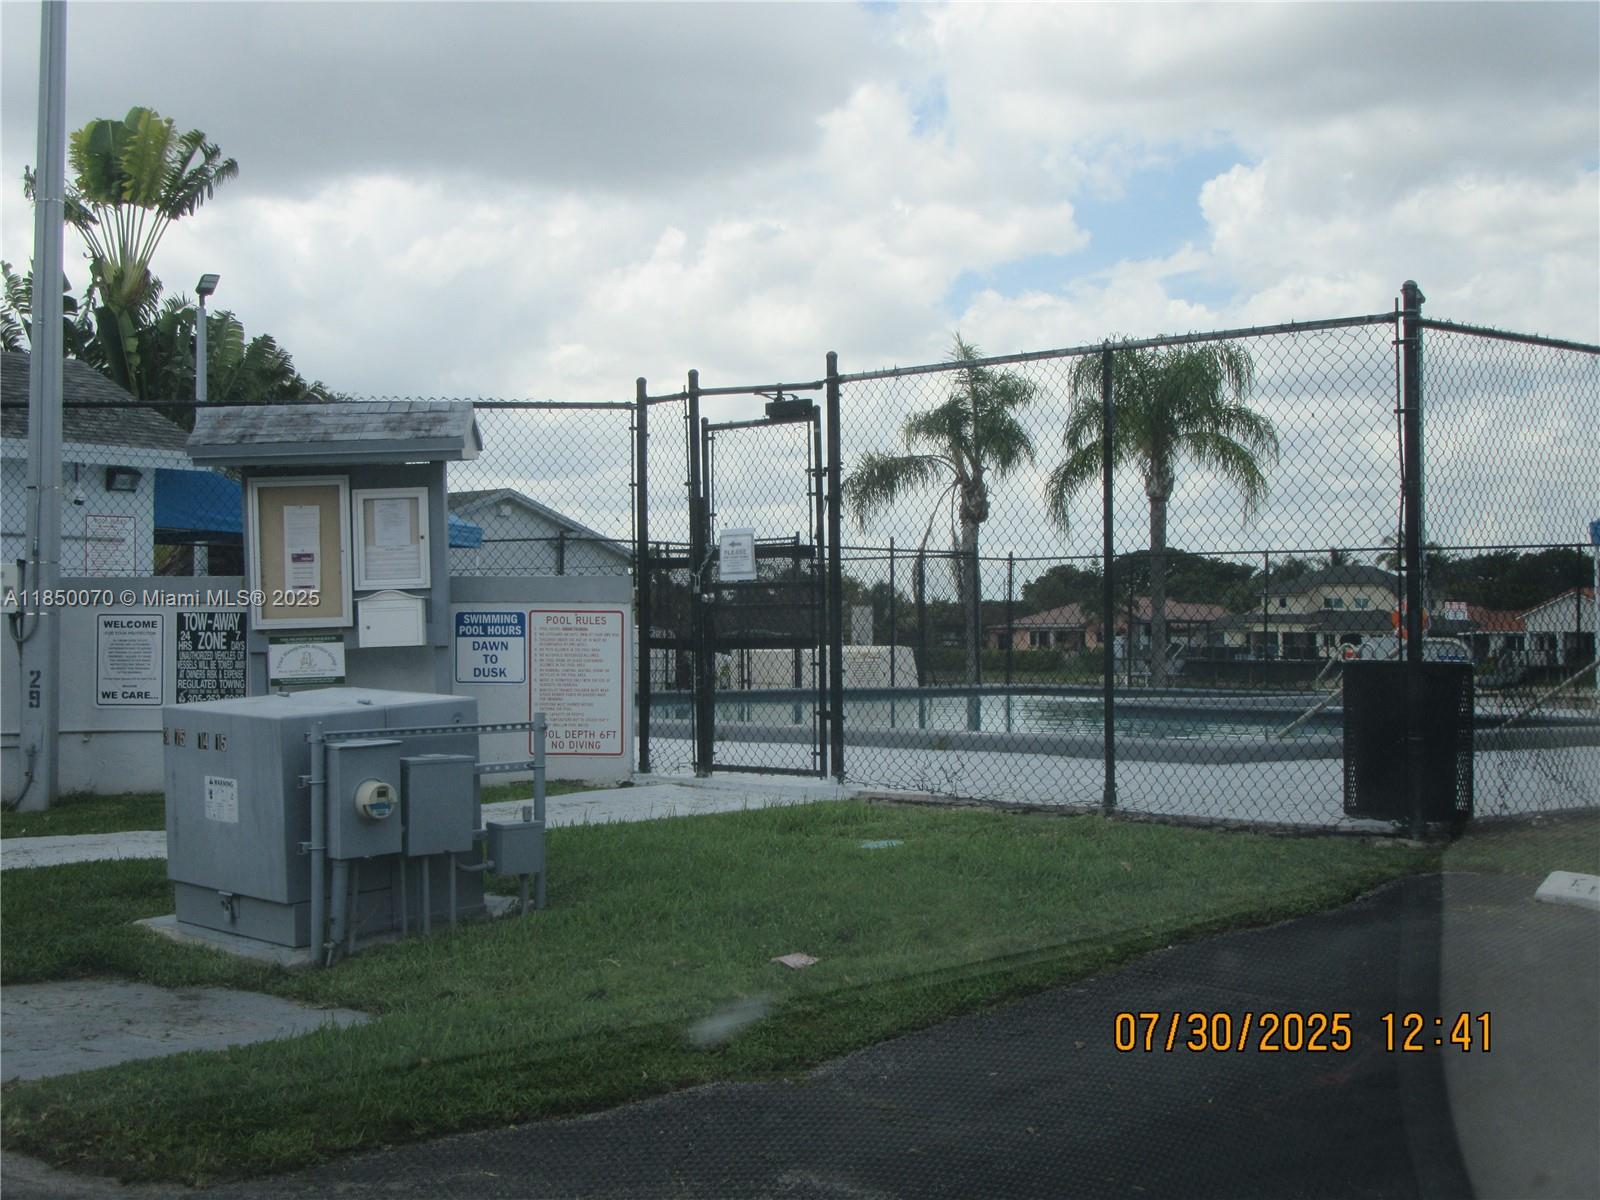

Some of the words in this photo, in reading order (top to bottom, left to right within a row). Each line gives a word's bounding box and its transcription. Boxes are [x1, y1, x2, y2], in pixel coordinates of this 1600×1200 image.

[183, 612, 241, 631] TOW-AWAY
[463, 614, 518, 624] SWIMMING
[545, 615, 572, 625] POOL
[575, 616, 607, 625] RULES
[103, 620, 158, 628] WELCOME
[459, 625, 485, 635] POOL
[487, 626, 522, 636] HOURS
[180, 631, 191, 640] 24
[235, 631, 241, 640] 7
[197, 631, 227, 650] ZONE
[178, 641, 193, 650] HRS
[230, 641, 245, 650] DAYS
[472, 641, 509, 650] DAWN
[483, 654, 498, 664] TO
[473, 667, 508, 677] DUSK
[177, 680, 217, 688] REGULATED
[219, 680, 245, 689] TOWING
[101, 691, 118, 699] WE
[544, 730, 560, 739] OOL
[564, 730, 595, 739] DEPTH
[599, 730, 617, 739] 6FT
[551, 741, 565, 749] NO
[568, 741, 601, 750] DIVING
